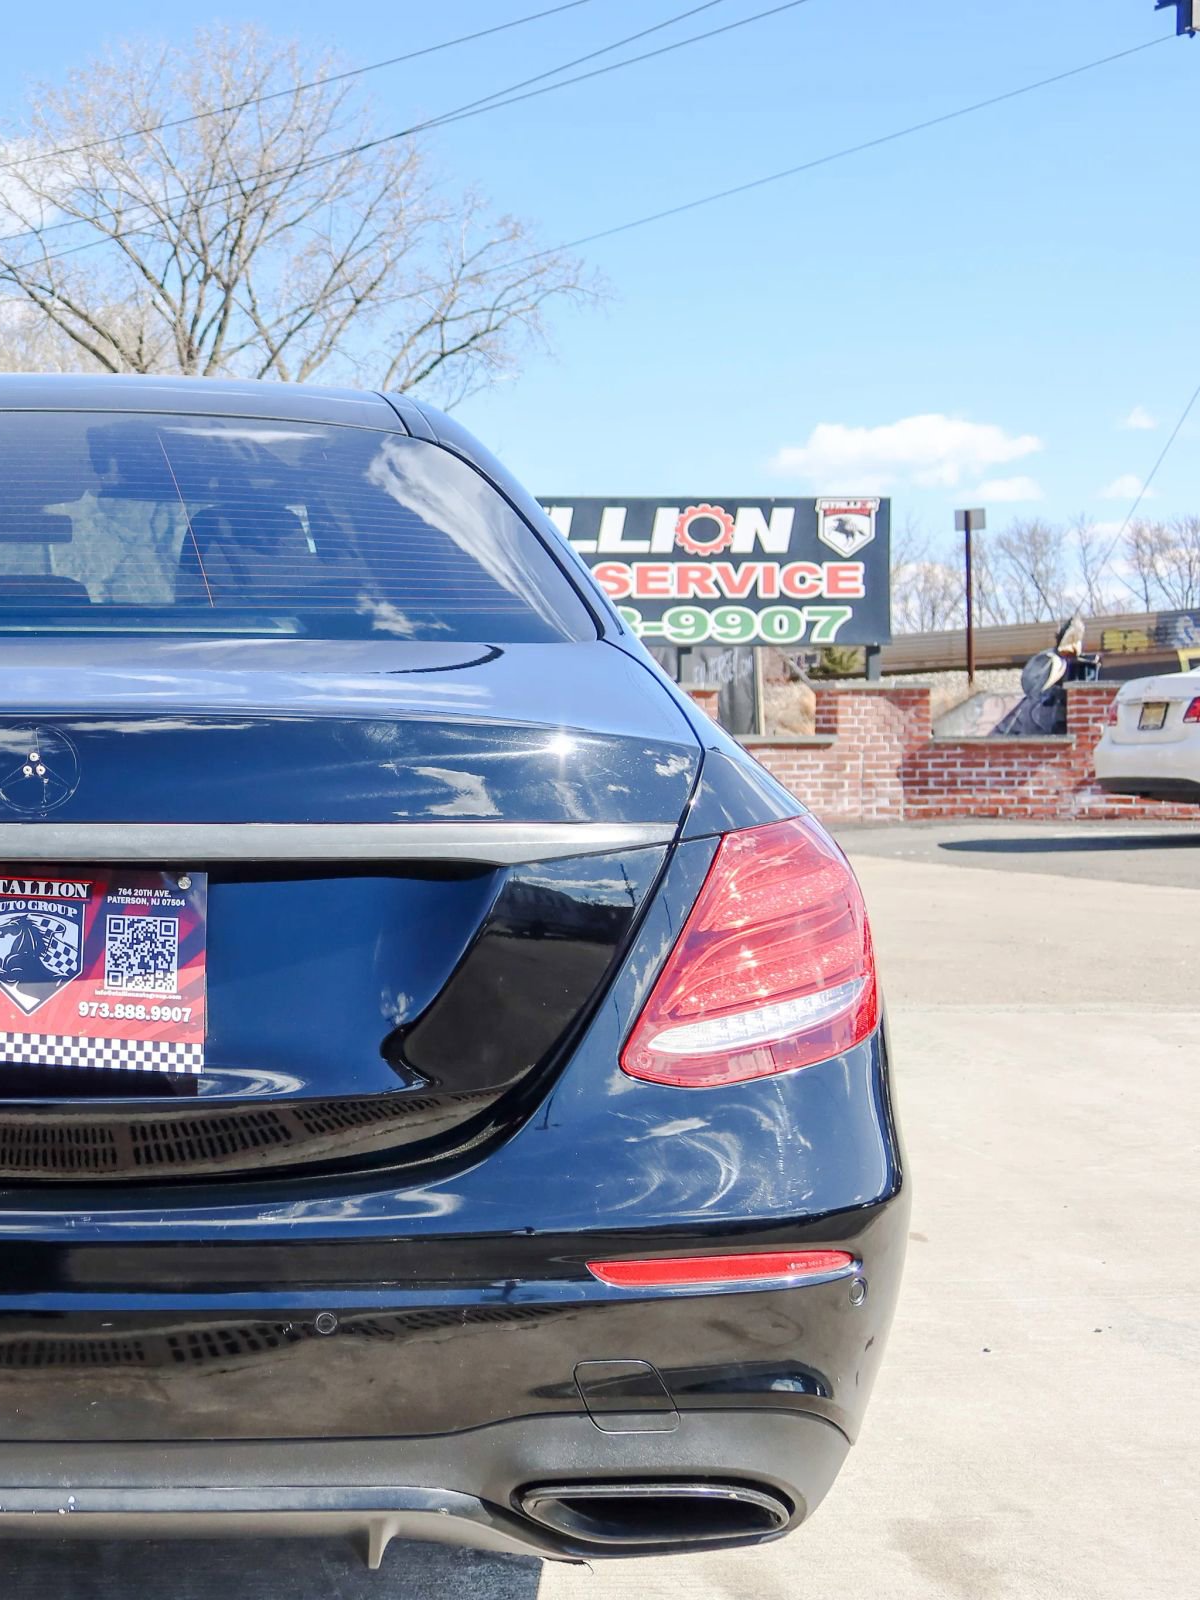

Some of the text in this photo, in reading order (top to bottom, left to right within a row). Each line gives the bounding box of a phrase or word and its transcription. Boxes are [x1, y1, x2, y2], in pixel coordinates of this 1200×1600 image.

[544, 504, 796, 556] LLION
[590, 561, 865, 599] SERVICE
[107, 896, 149, 906] PATERSON,
[151, 898, 160, 906] NJ
[134, 888, 153, 897] 20TH
[154, 890, 171, 898] AVE.
[28, 901, 78, 917] GROUP
[78, 1001, 192, 1023] 973.888.9907
